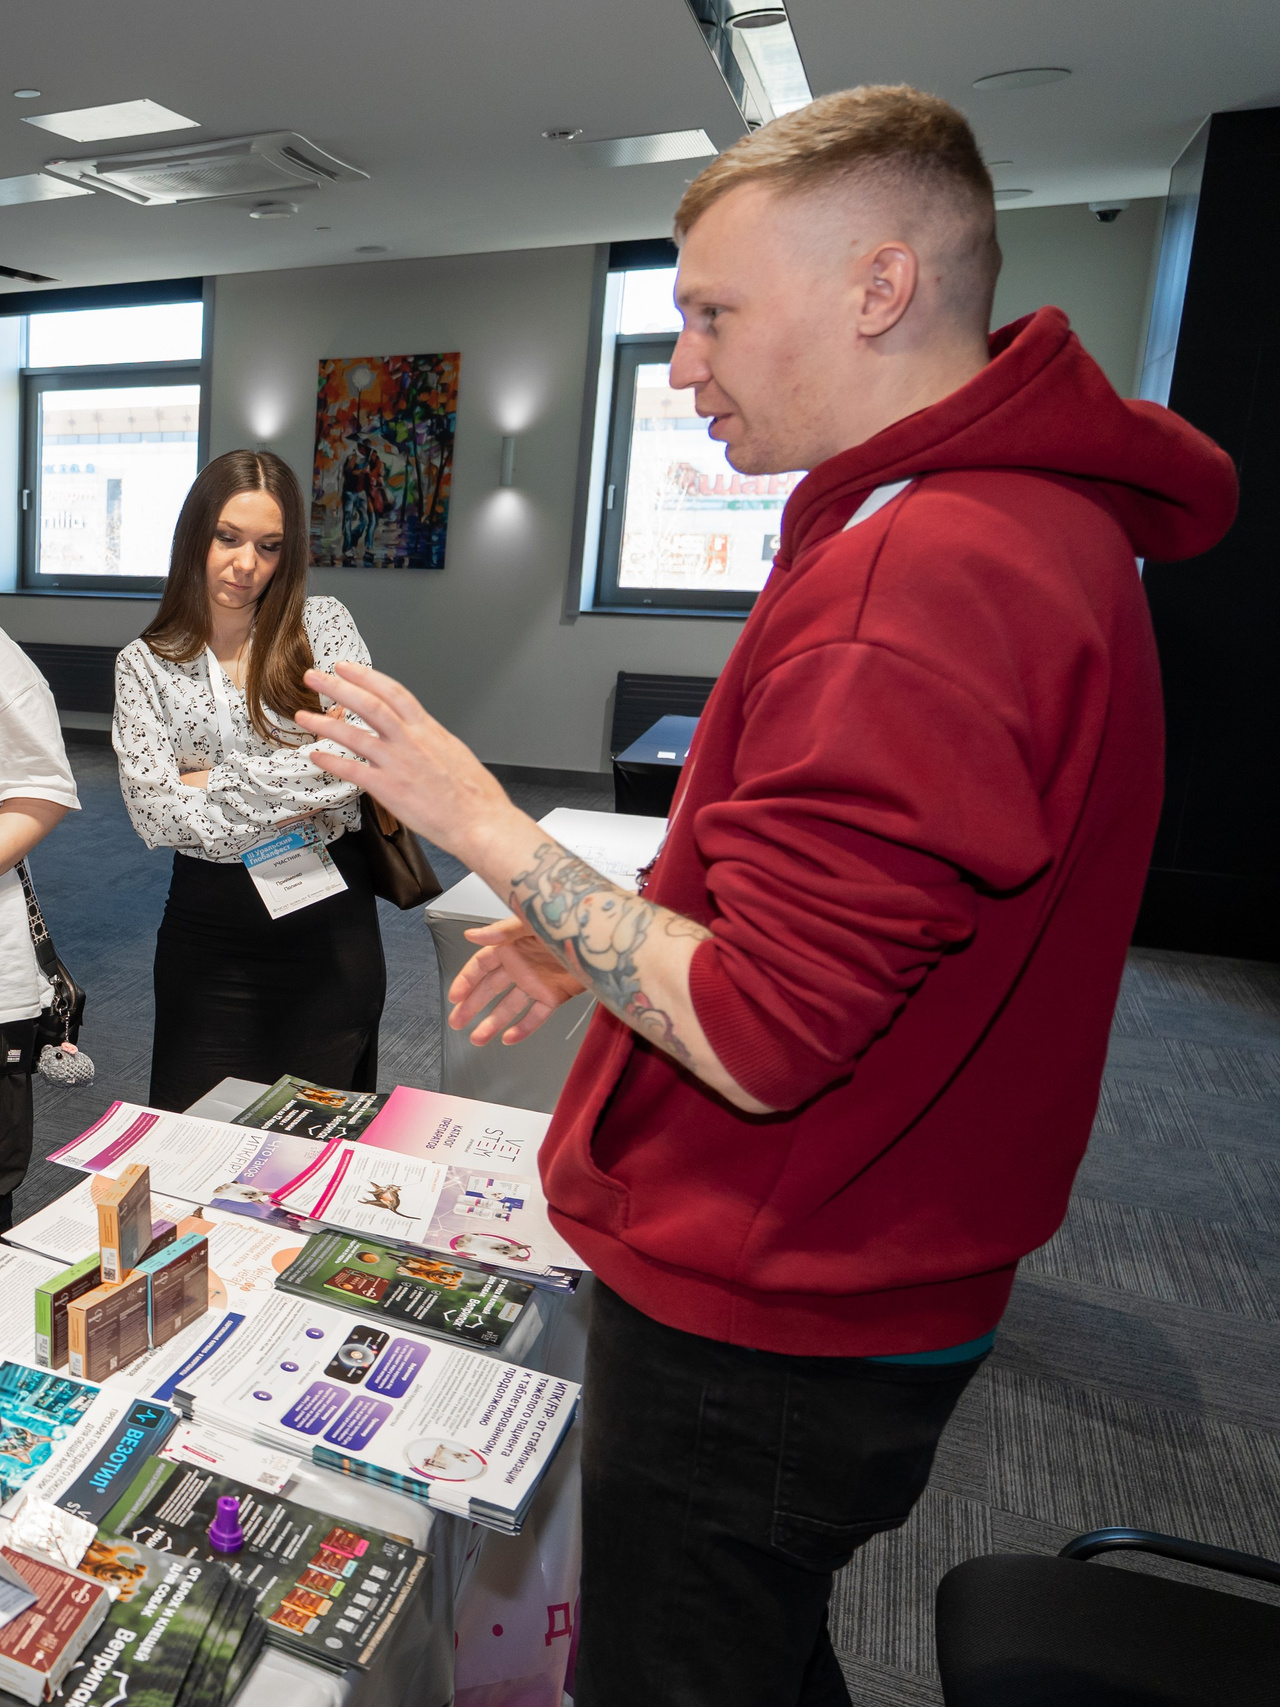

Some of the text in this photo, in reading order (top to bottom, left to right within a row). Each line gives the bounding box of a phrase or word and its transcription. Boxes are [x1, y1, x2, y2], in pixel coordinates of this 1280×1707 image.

[249, 844, 291, 866] Глобалфест
[254, 836, 293, 860] Уральский
[273, 852, 302, 868] УЧАСТНИК
[425, 1117, 452, 1150] ПРЕПАРАТОВ
[442, 1124, 463, 1149] КАТАЛОГ
[472, 1126, 504, 1158] STEM
[497, 1136, 524, 1163] VET
[224, 1135, 263, 1175] ИПК/FIP?
[243, 1139, 282, 1179] Что такое
[478, 1275, 496, 1298] ДЛЯ СОБАК
[494, 1283, 506, 1295] БЛОХ
[452, 1298, 481, 1328] Веприпак
[482, 1298, 498, 1315] КЛЕЩЕЙ
[478, 1366, 516, 1427] продолжению
[478, 1378, 529, 1457] таблетированному
[500, 1377, 549, 1457] тяжёлого пациента
[503, 1381, 569, 1485] ИПК/FIP: от стабилизации
[36, 1422, 95, 1490] ДЛЯ ОБЩЕЙ АНЕСТЕЗИИ
[41, 1408, 119, 1502] ПРЕПАРАТ ПОСЛЕДНЕГО ПОКОЛЕ
[88, 1428, 145, 1490] ВЕЗОТИЛ
[139, 1562, 184, 1619] ДЛЯ СОБАК
[133, 1566, 203, 1664] ОТ БЛОХ И КЛЕЩЕЙ
